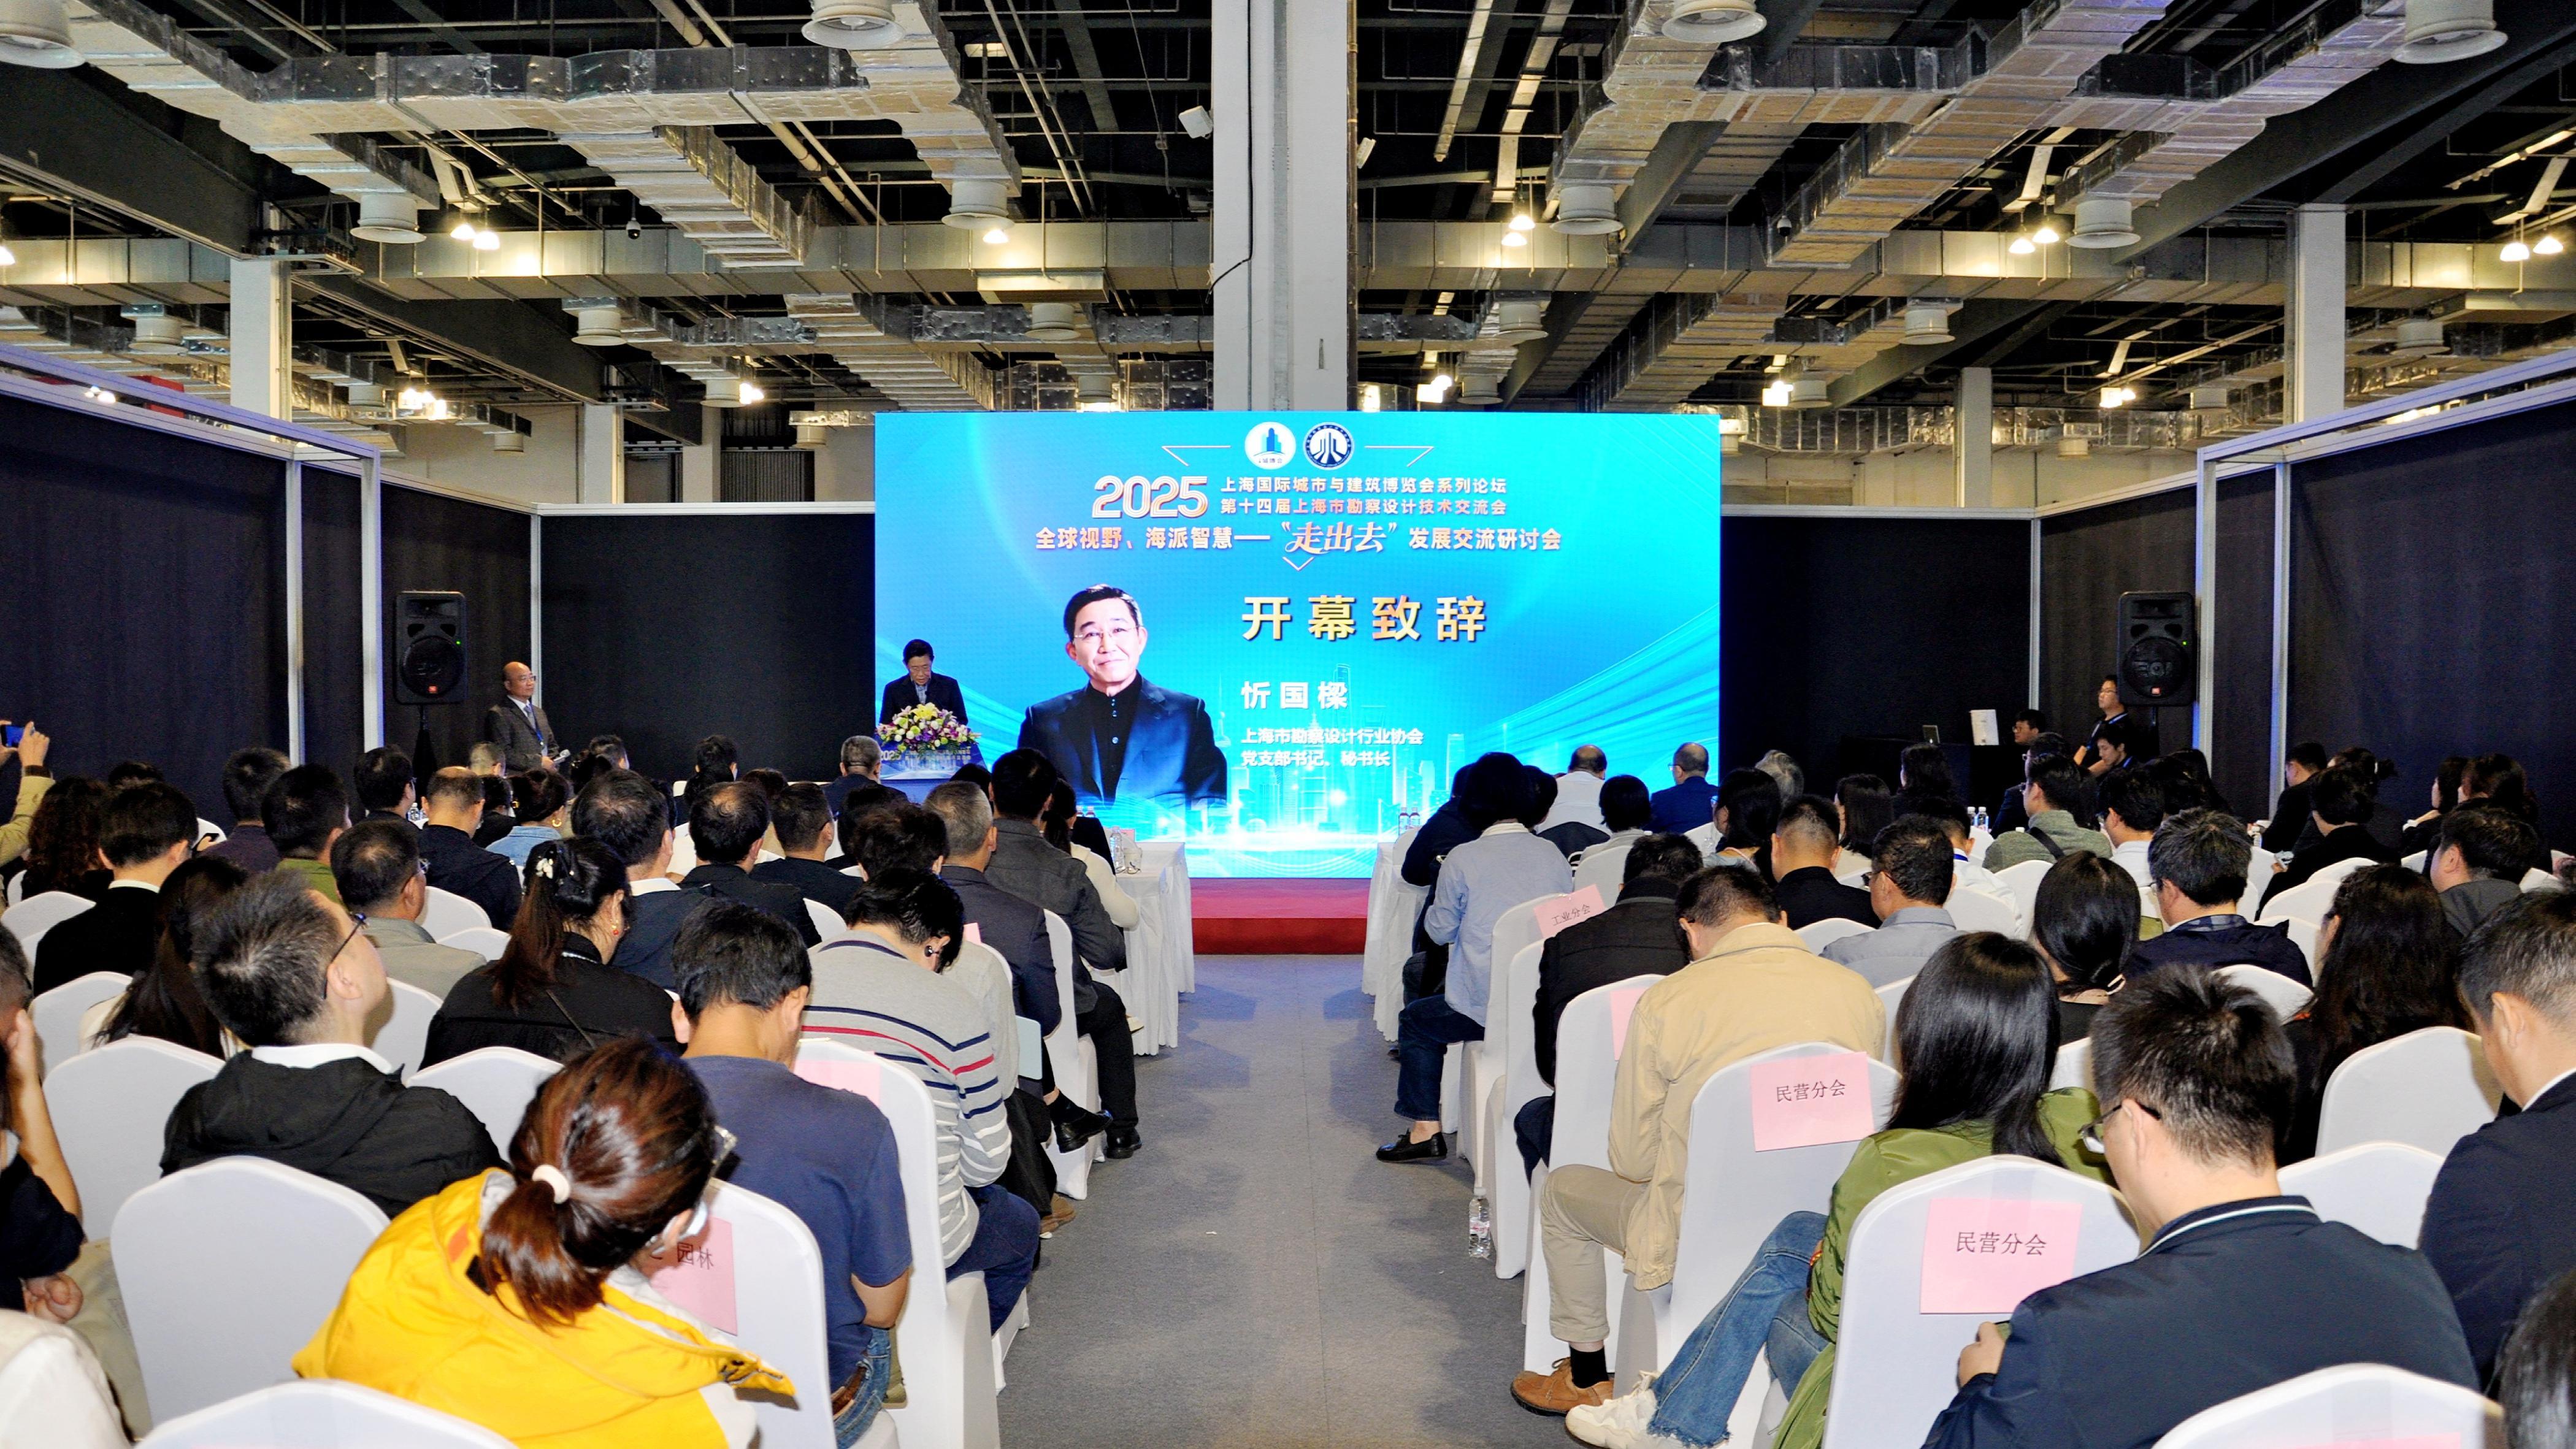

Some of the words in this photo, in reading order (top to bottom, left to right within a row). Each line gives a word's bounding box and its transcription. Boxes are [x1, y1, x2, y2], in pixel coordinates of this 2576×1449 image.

[1092, 475, 1208, 519] 2025
[1221, 476, 1507, 494] 上海国际城市与建筑博览会系列论坛
[1221, 498, 1507, 515] 第十四届上海市勘察设计技术交流会
[1241, 595, 1487, 641] 开幕致辞
[1241, 681, 1349, 709] 忻国樑
[1241, 728, 1424, 745] 上海市勘察设计行业协会
[1241, 750, 1390, 767] 党支部书记、秘书长
[1551, 904, 1590, 927] 工业分会
[1776, 1078, 1846, 1103] 民营分会
[1955, 1231, 2048, 1256] 民营分会
